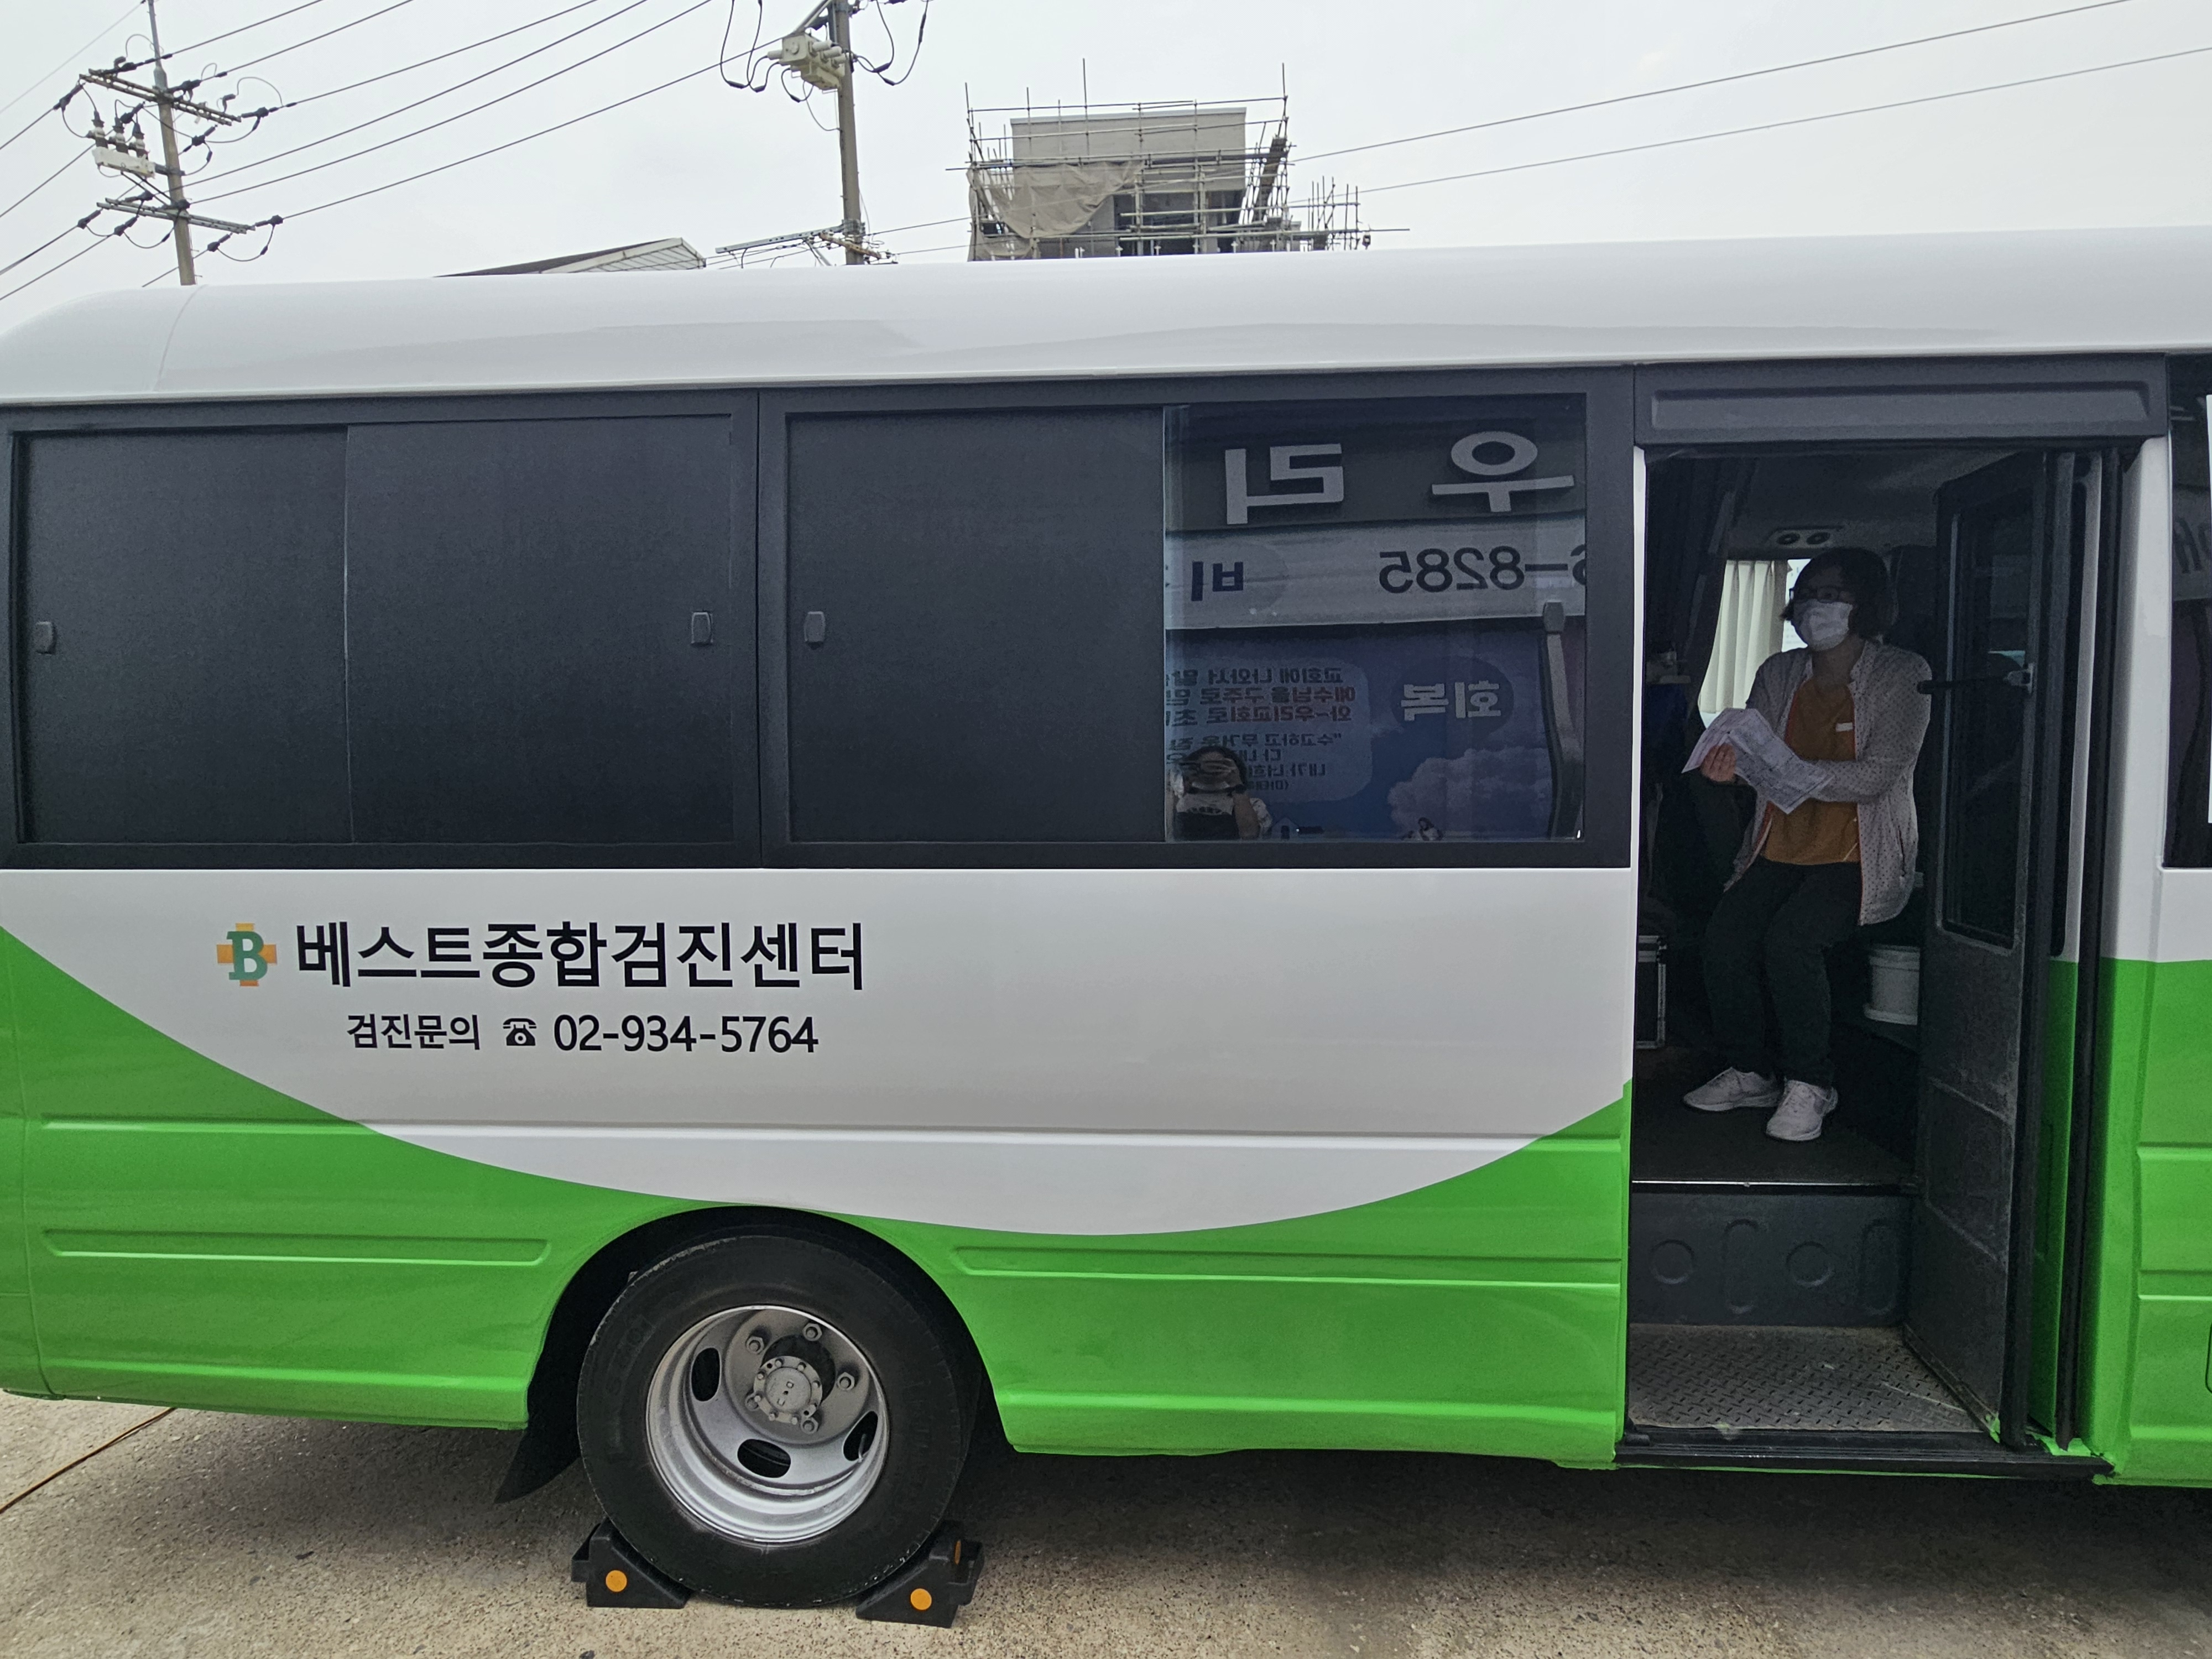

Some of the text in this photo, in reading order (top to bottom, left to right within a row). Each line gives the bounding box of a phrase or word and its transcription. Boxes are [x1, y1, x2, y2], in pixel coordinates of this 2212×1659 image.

[226, 930, 269, 982] B
[296, 921, 864, 990] 베스트종합검진센터
[346, 1013, 819, 1053] 검진문의 02-934-5764
